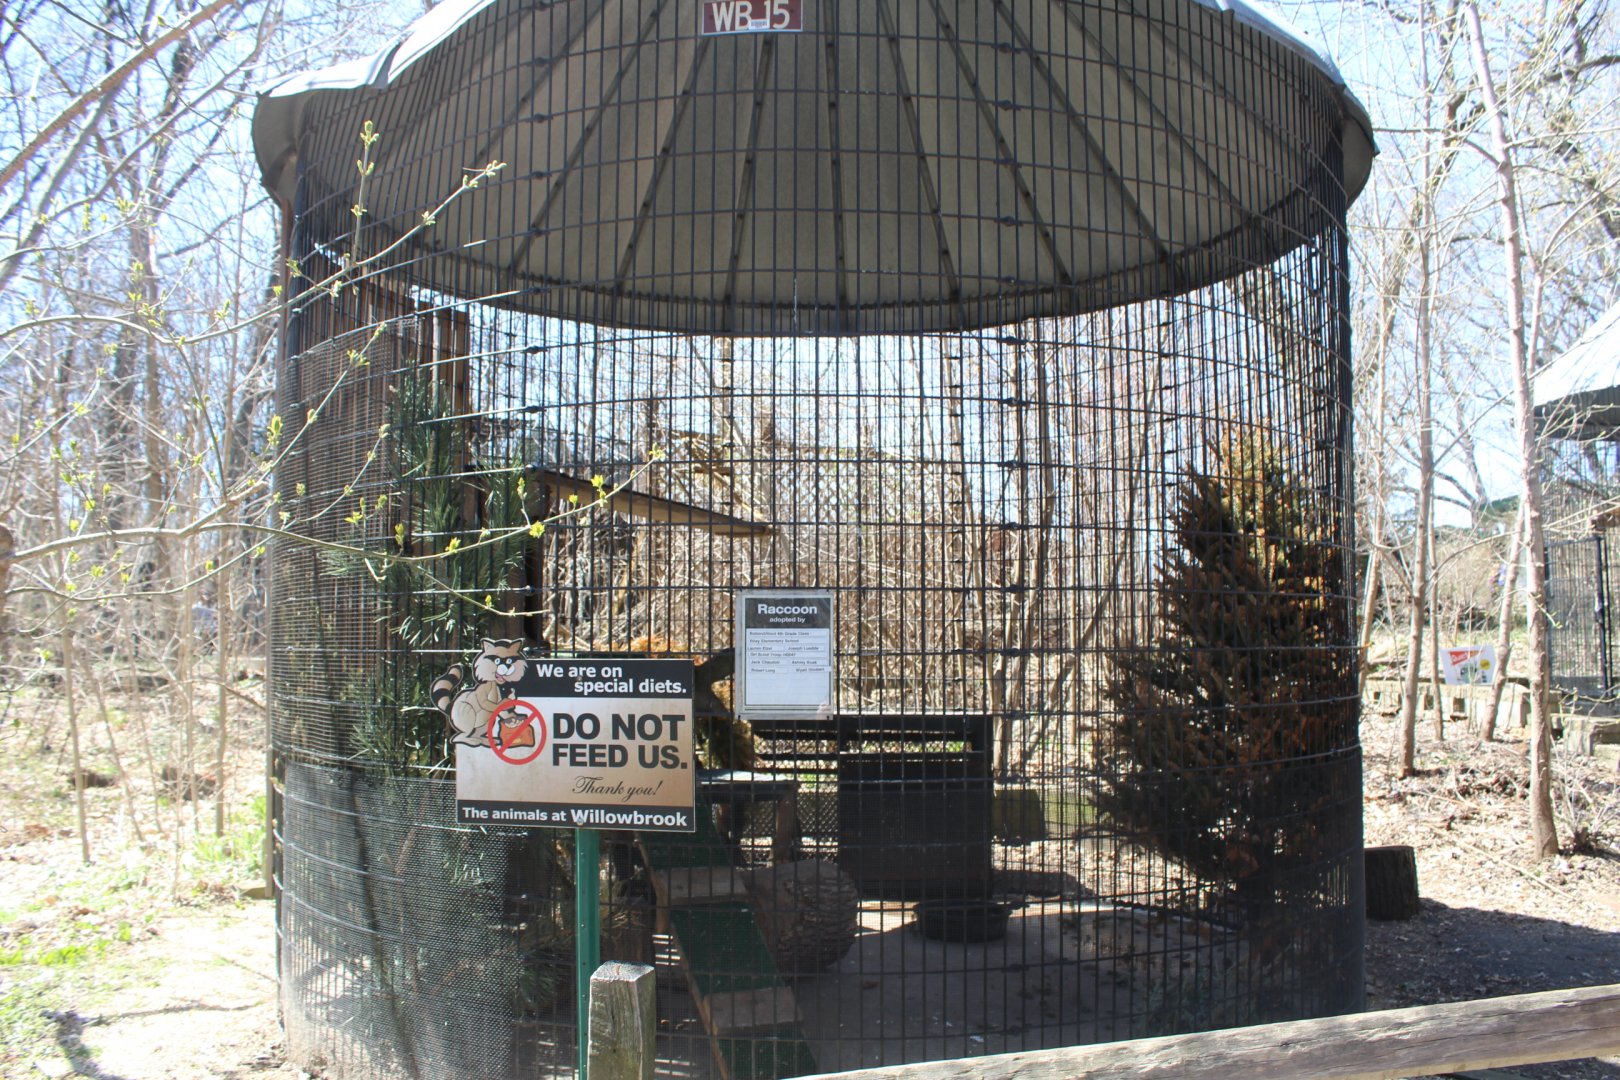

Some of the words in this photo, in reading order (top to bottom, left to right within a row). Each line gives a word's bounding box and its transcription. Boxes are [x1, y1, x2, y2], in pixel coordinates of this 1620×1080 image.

[712, 1, 752, 31] WB
[764, 0, 790, 29] 15
[757, 603, 818, 615] Raccoon
[536, 664, 563, 678] We
[568, 667, 597, 678] are
[601, 666, 623, 678] on
[574, 678, 634, 695] special
[638, 679, 687, 694] diets.
[552, 713, 600, 740] DO
[612, 714, 685, 741] NOT
[552, 744, 628, 767] FEED
[638, 745, 688, 769] US.
[572, 775, 625, 796] Thank
[626, 780, 663, 802] you!
[462, 806, 489, 819] The
[491, 808, 549, 821] animals
[551, 810, 567, 822] at
[570, 808, 688, 827] Willowbrook
